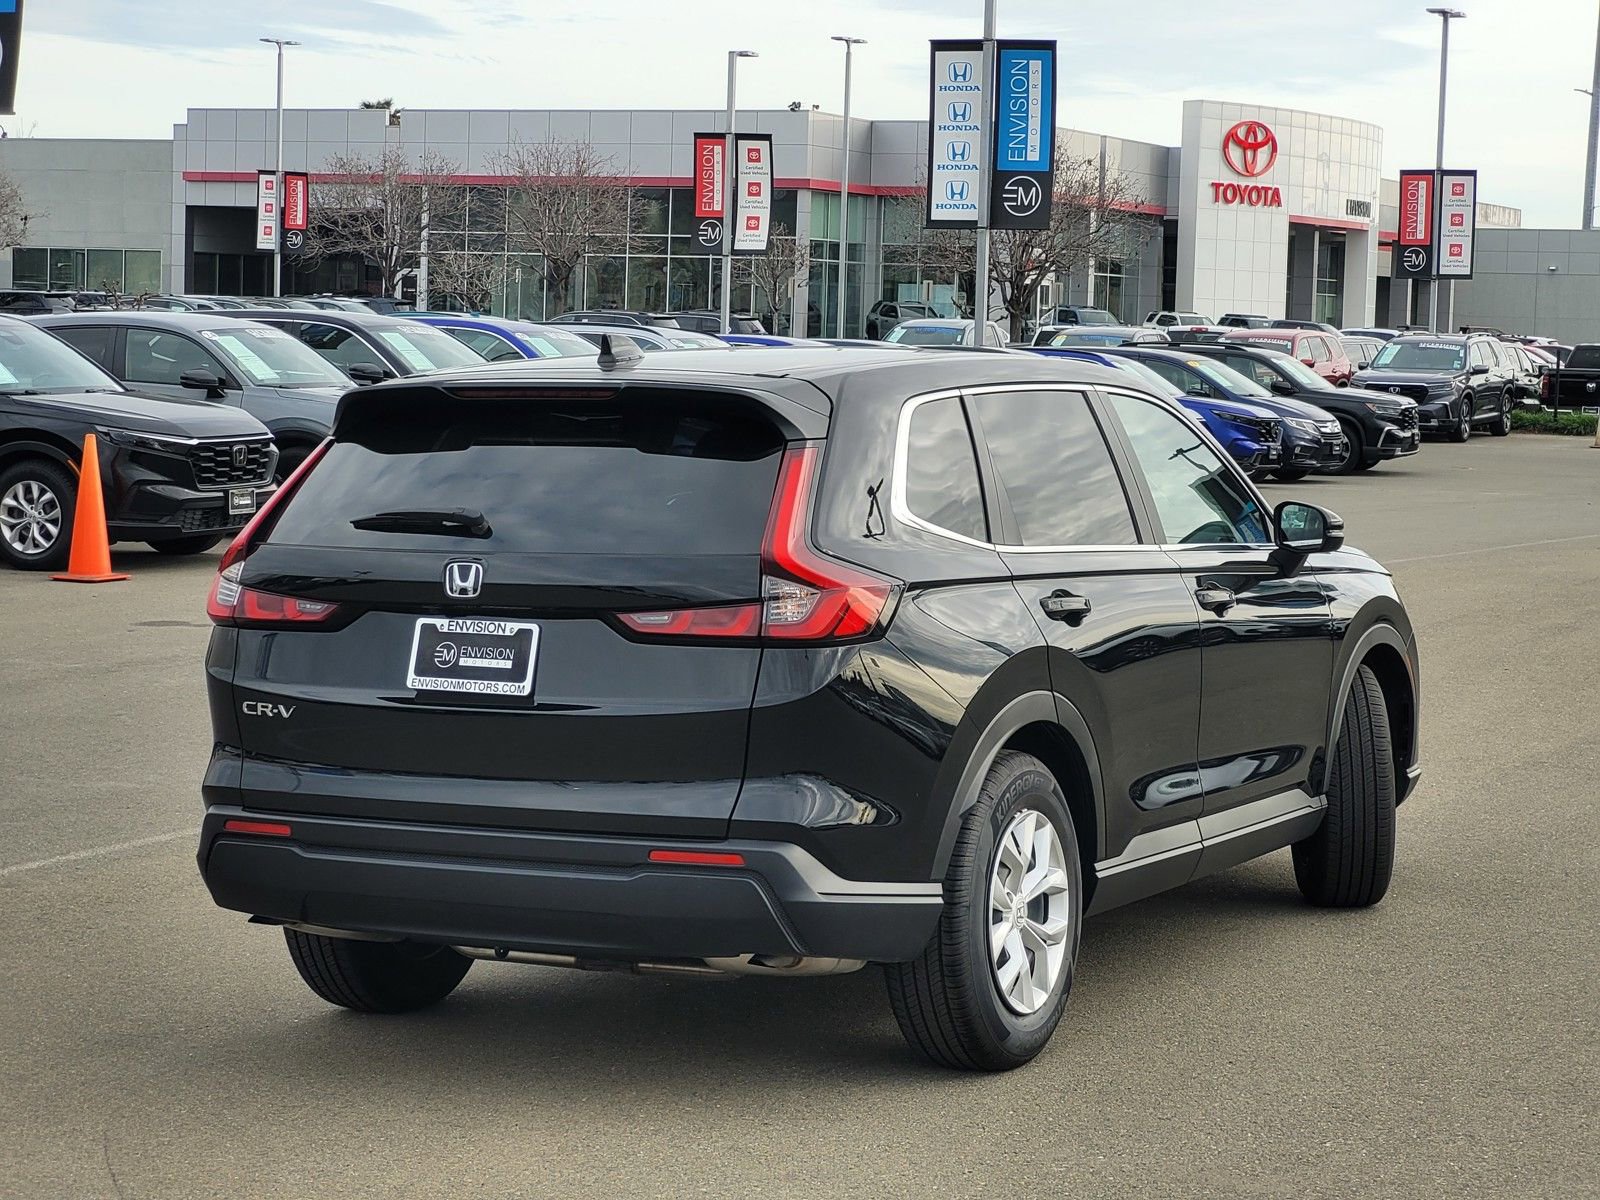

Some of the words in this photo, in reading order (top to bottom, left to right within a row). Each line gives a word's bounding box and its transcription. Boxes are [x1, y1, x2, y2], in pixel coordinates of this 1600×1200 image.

[1008, 60, 1028, 161] ENVISION
[1030, 69, 1039, 152] MOTORS
[702, 145, 713, 210] ENVISION
[1211, 182, 1282, 208] TOYOTA
[1406, 181, 1418, 239] ENVISION
[448, 620, 507, 634] ENVISION
[460, 646, 514, 660] ENVISION
[411, 678, 525, 694] ENVISIONMOTORS.COM
[242, 701, 296, 718] CR-V
